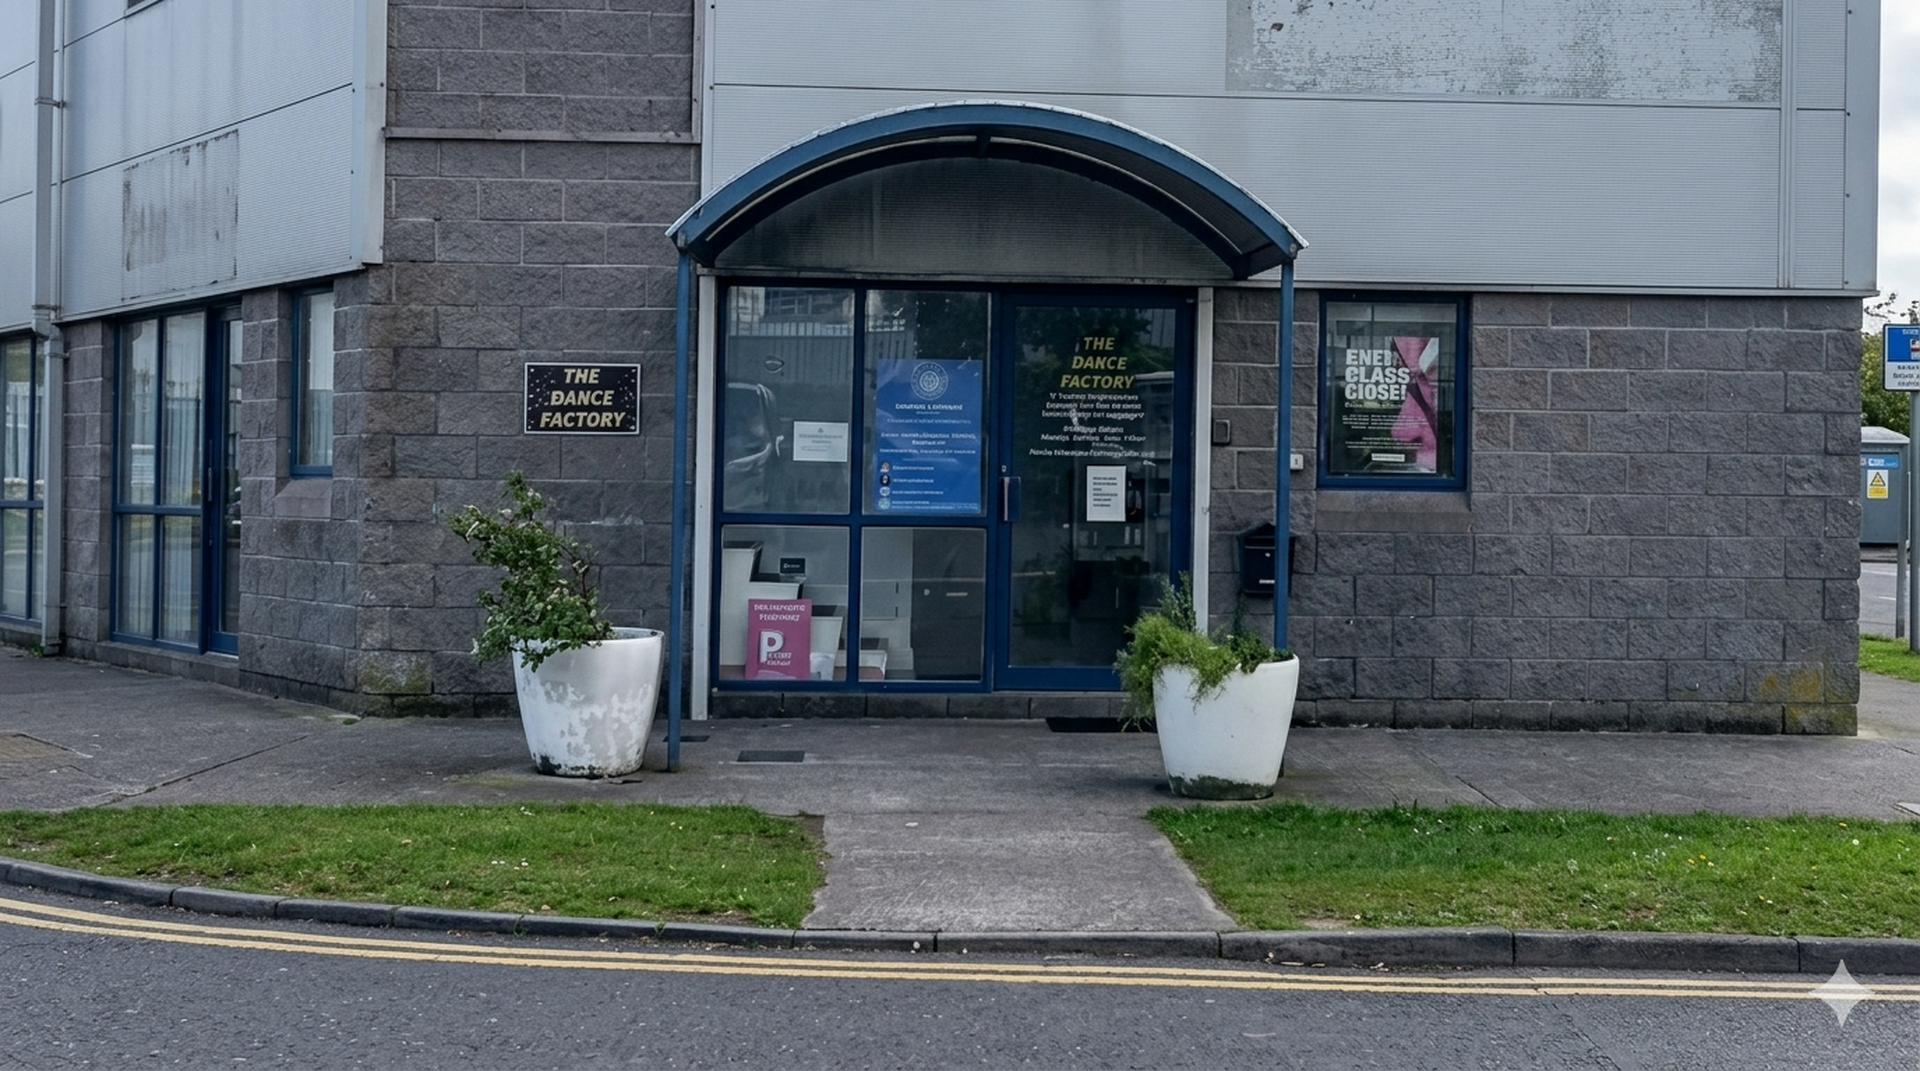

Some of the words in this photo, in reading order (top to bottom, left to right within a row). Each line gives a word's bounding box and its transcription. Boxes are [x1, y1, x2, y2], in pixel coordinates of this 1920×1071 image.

[1083, 337, 1115, 351] THE
[1071, 356, 1128, 370] DANCE
[564, 368, 600, 384] THE
[1060, 374, 1134, 389] FACTORY
[1345, 366, 1410, 384] CLASS
[550, 390, 614, 406] DANCE
[539, 412, 626, 428] FACTORY
